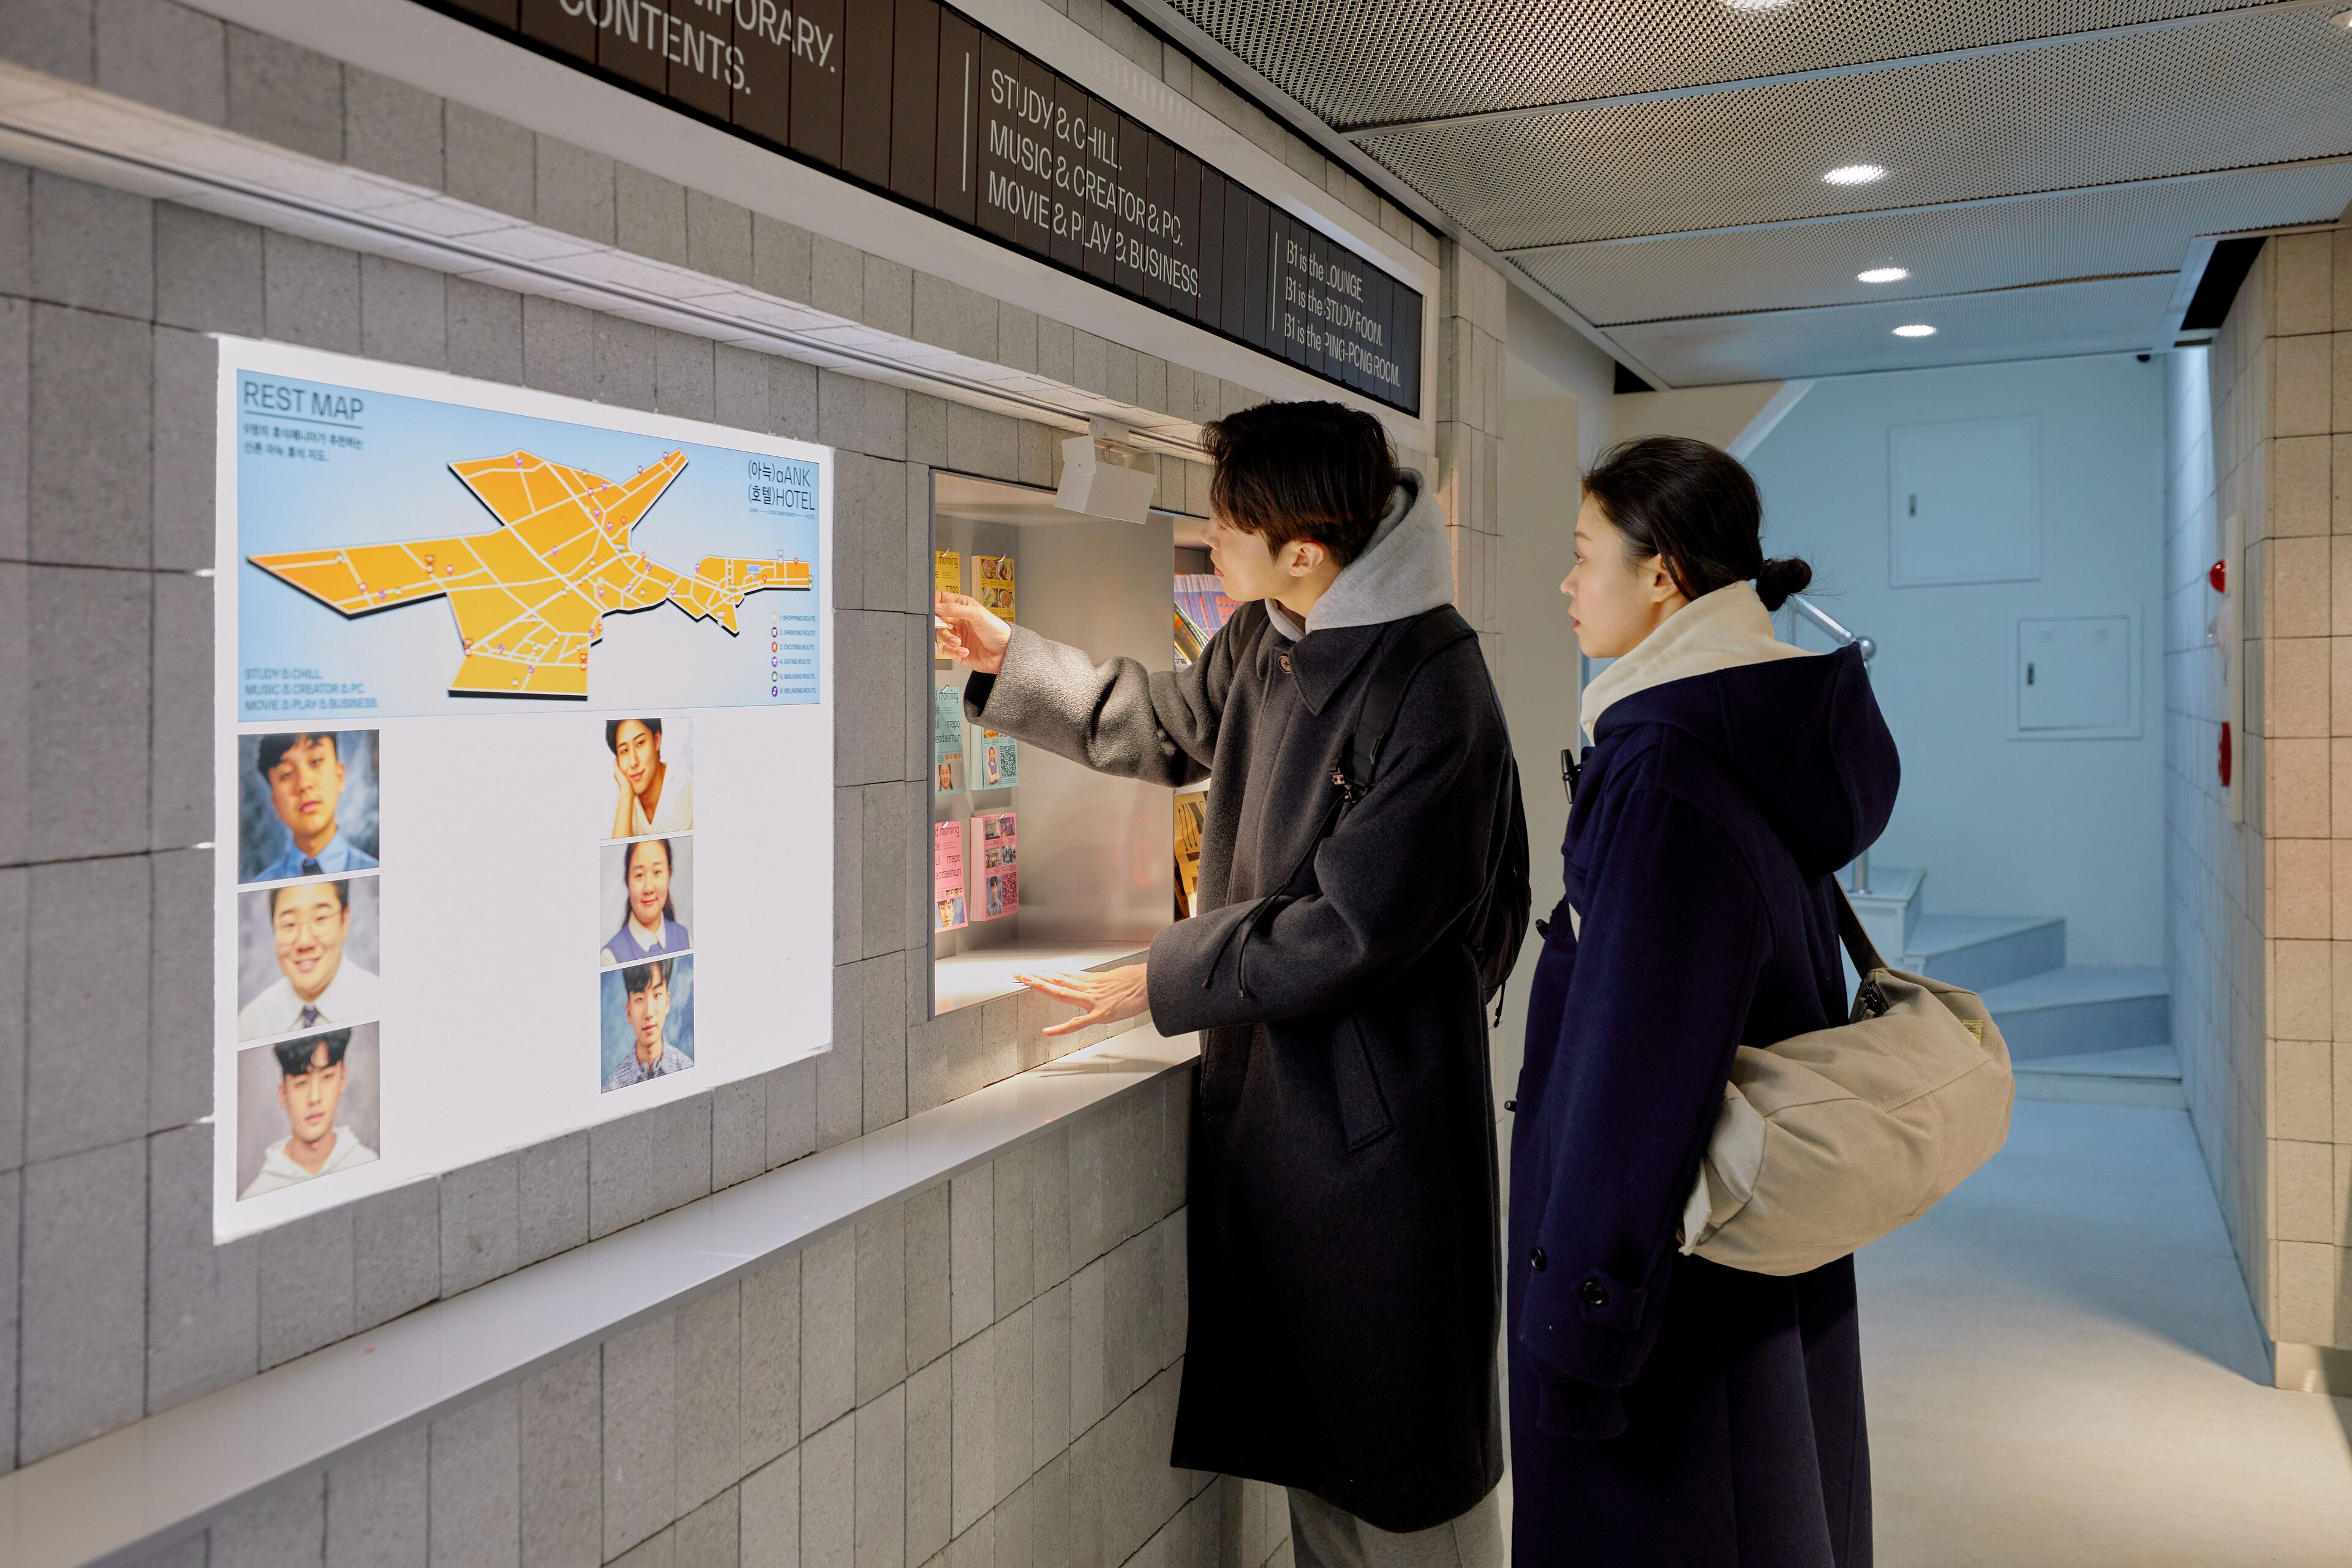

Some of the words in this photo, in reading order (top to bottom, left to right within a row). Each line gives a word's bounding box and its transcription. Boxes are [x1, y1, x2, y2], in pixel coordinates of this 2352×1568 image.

[695, 0, 835, 73] ORARY.
[991, 69, 1054, 129] STUDY
[1056, 107, 1069, 142] &
[1074, 118, 1122, 170] CHILL.
[990, 119, 1052, 179] MUSIC
[1056, 156, 1069, 190] &
[1074, 165, 1145, 228] CREATOR
[1148, 204, 1159, 235] &
[1163, 210, 1183, 246] PC.
[989, 170, 1049, 229] MOVIE
[1054, 203, 1067, 236] &
[1072, 211, 1112, 255] PLAY
[1115, 232, 1126, 263] &
[1130, 238, 1201, 298] BUSINESS.
[1287, 239, 1298, 266] B1
[1300, 247, 1306, 273] is
[1309, 253, 1324, 281] the
[1326, 263, 1363, 303] LOUNGE.
[1286, 277, 1296, 303] B1
[1298, 284, 1306, 308] is
[1308, 288, 1322, 316] the
[1324, 297, 1355, 329] STUDY
[1355, 311, 1382, 347] ROOM.
[1284, 313, 1295, 339] B1
[1297, 320, 1305, 344] is
[1306, 323, 1321, 352] the
[1324, 332, 1373, 375] PING-PONG
[1374, 355, 1400, 387] ROOM.
[244, 382, 306, 412] REST
[312, 393, 363, 420] MAP
[938, 555, 957, 568] morning
[245, 668, 278, 679] STUDY
[245, 684, 280, 695] MUSIC
[293, 683, 339, 694] CREATOR
[939, 690, 959, 703] morning
[245, 699, 279, 710] MOVIE
[293, 699, 315, 710] PLAY
[946, 720, 960, 731] mapo
[940, 823, 959, 837] morning
[947, 854, 961, 865] mapo
